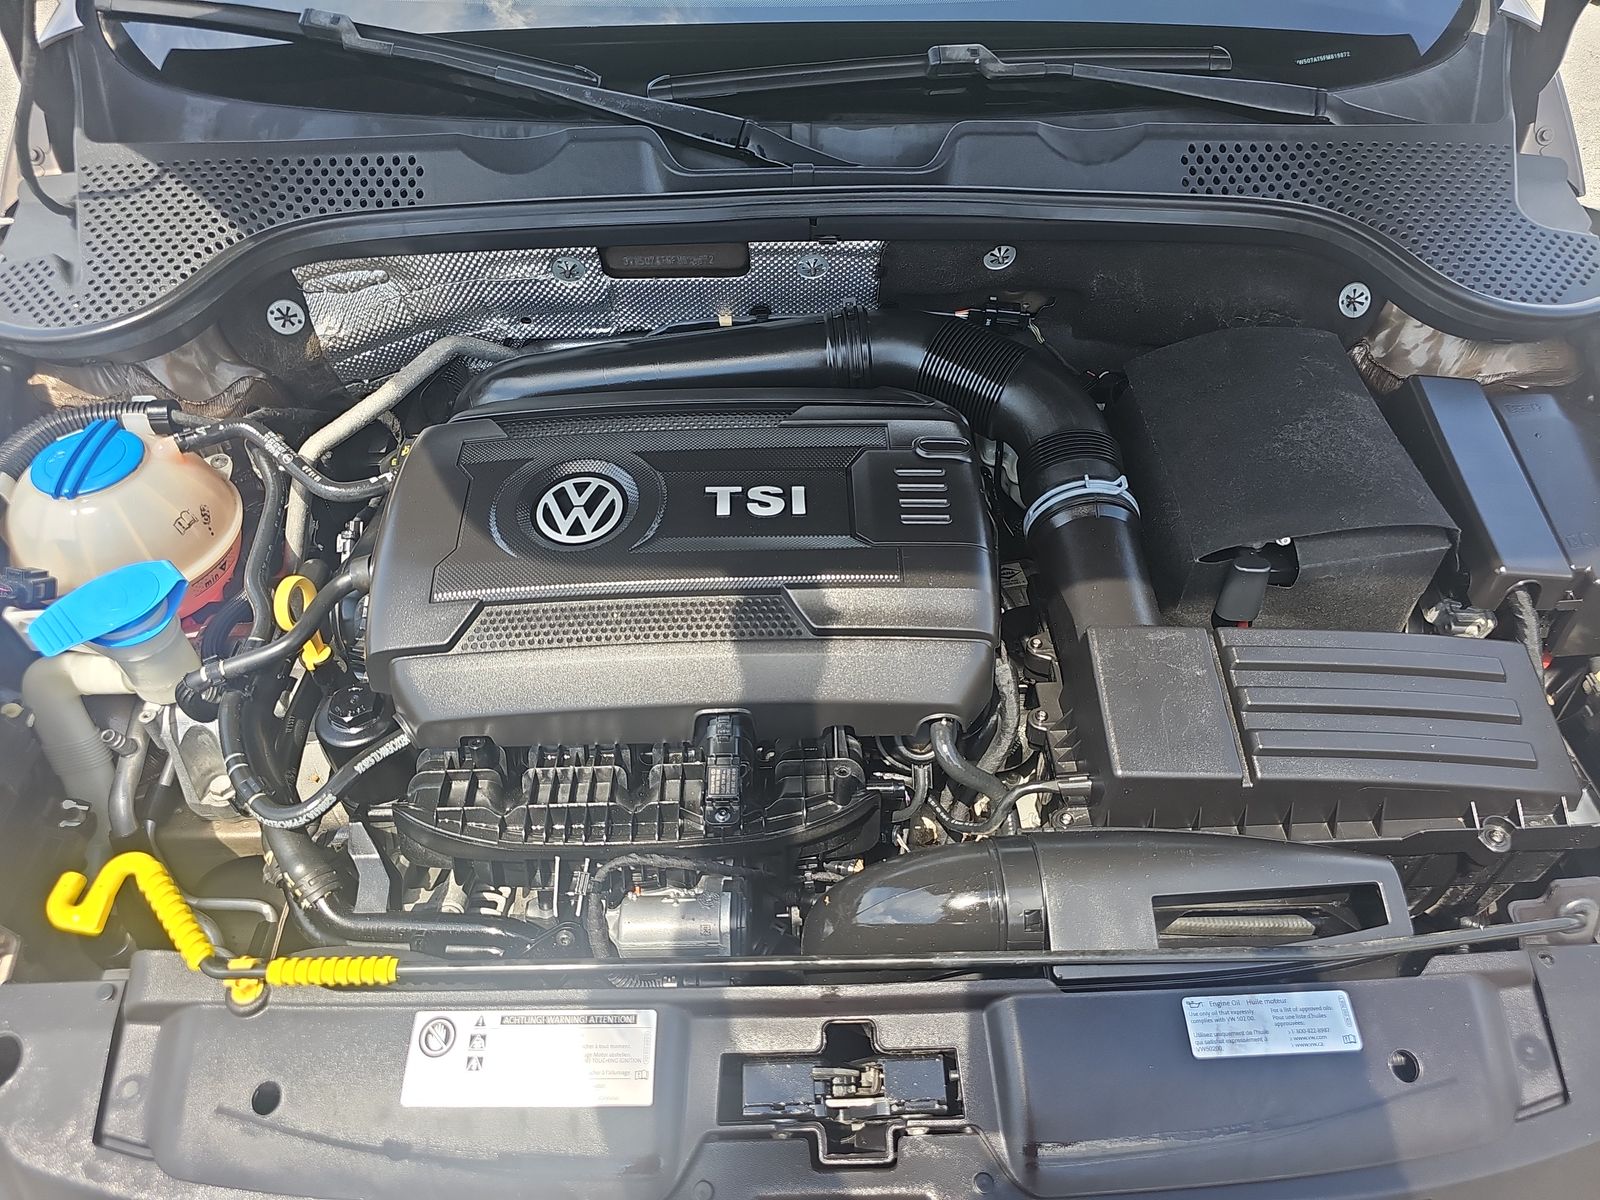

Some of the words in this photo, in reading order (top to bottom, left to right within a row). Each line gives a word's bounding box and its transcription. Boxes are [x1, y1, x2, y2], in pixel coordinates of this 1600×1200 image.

[705, 486, 806, 516] TSI
[205, 574, 219, 588] min
[1208, 1000, 1231, 1008] Engine
[546, 1015, 588, 1024] WARNING!
[589, 1014, 635, 1024] ATTENTION!
